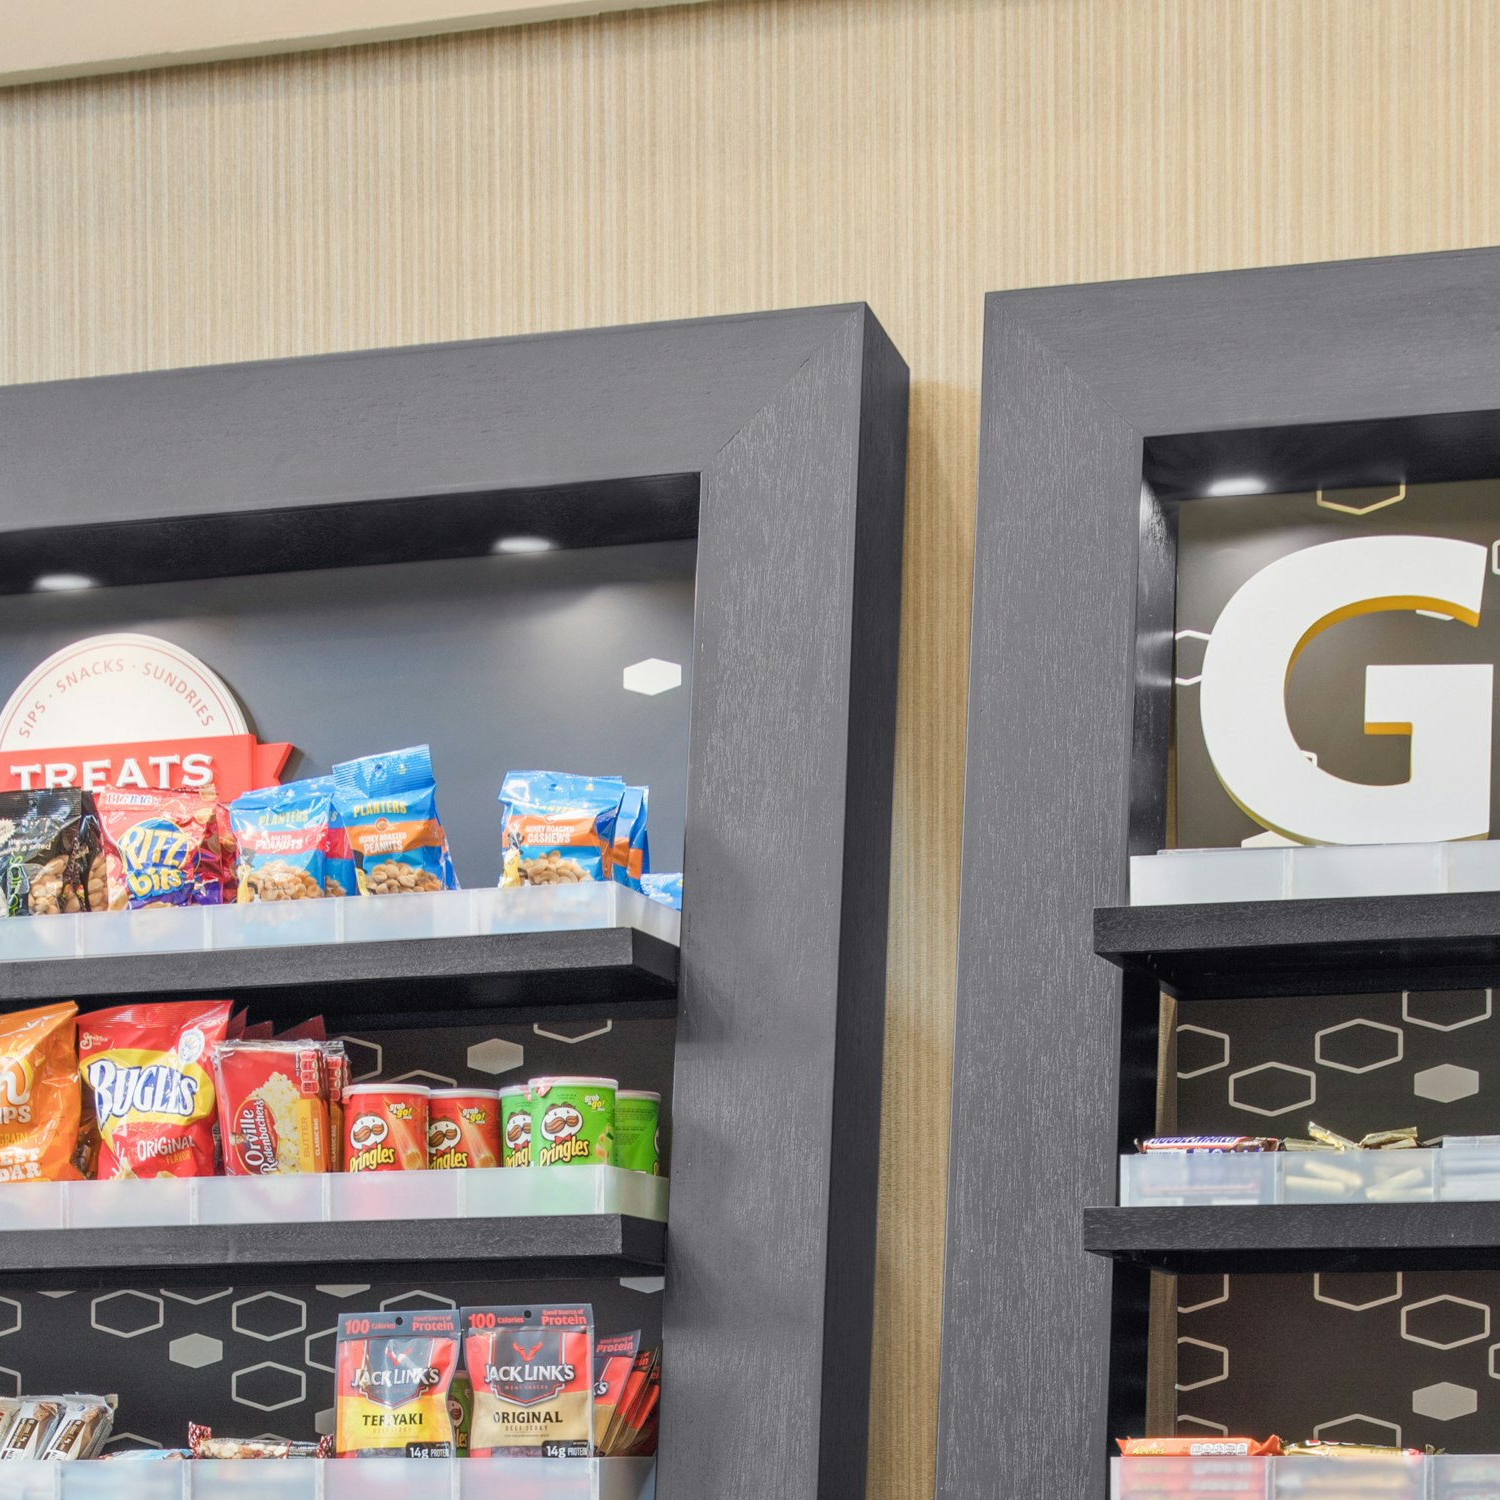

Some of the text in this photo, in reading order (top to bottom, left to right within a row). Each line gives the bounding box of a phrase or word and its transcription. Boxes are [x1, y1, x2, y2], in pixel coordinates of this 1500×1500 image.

[18, 658, 215, 739] SIPS SNACKS SUNDRIES
[10, 753, 214, 792] TREATS
[353, 800, 408, 818] PLANTERS
[259, 811, 309, 827] PLANTERS
[255, 837, 304, 851] PEANUTS
[363, 839, 404, 853] PEANUTS
[526, 832, 572, 844] CASHEWS
[122, 827, 188, 872] RITZ
[128, 866, 183, 898] bits
[87, 1058, 199, 1131] BUGLES
[396, 1107, 413, 1119] go!
[0, 1132, 28, 1147] GRAIN
[244, 1109, 261, 1167] Orville
[259, 1099, 278, 1176] Redenbacher's
[165, 1152, 191, 1165] FLAVOR
[349, 1145, 396, 1172] Pringles
[539, 1134, 590, 1167] Pringles
[345, 1318, 370, 1335] 100
[412, 1321, 454, 1332] Protein
[468, 1312, 525, 1330] 100 Calories
[541, 1313, 588, 1327] Protein
[595, 1340, 634, 1354] Protein
[350, 1366, 441, 1388] JACK LINK'S
[483, 1362, 575, 1383] JACK LINK'S
[361, 1412, 424, 1427] TERIYAKI
[493, 1410, 564, 1424] ORIGINAL
[409, 1445, 429, 1460] 14g
[545, 1445, 567, 1459] 14g
